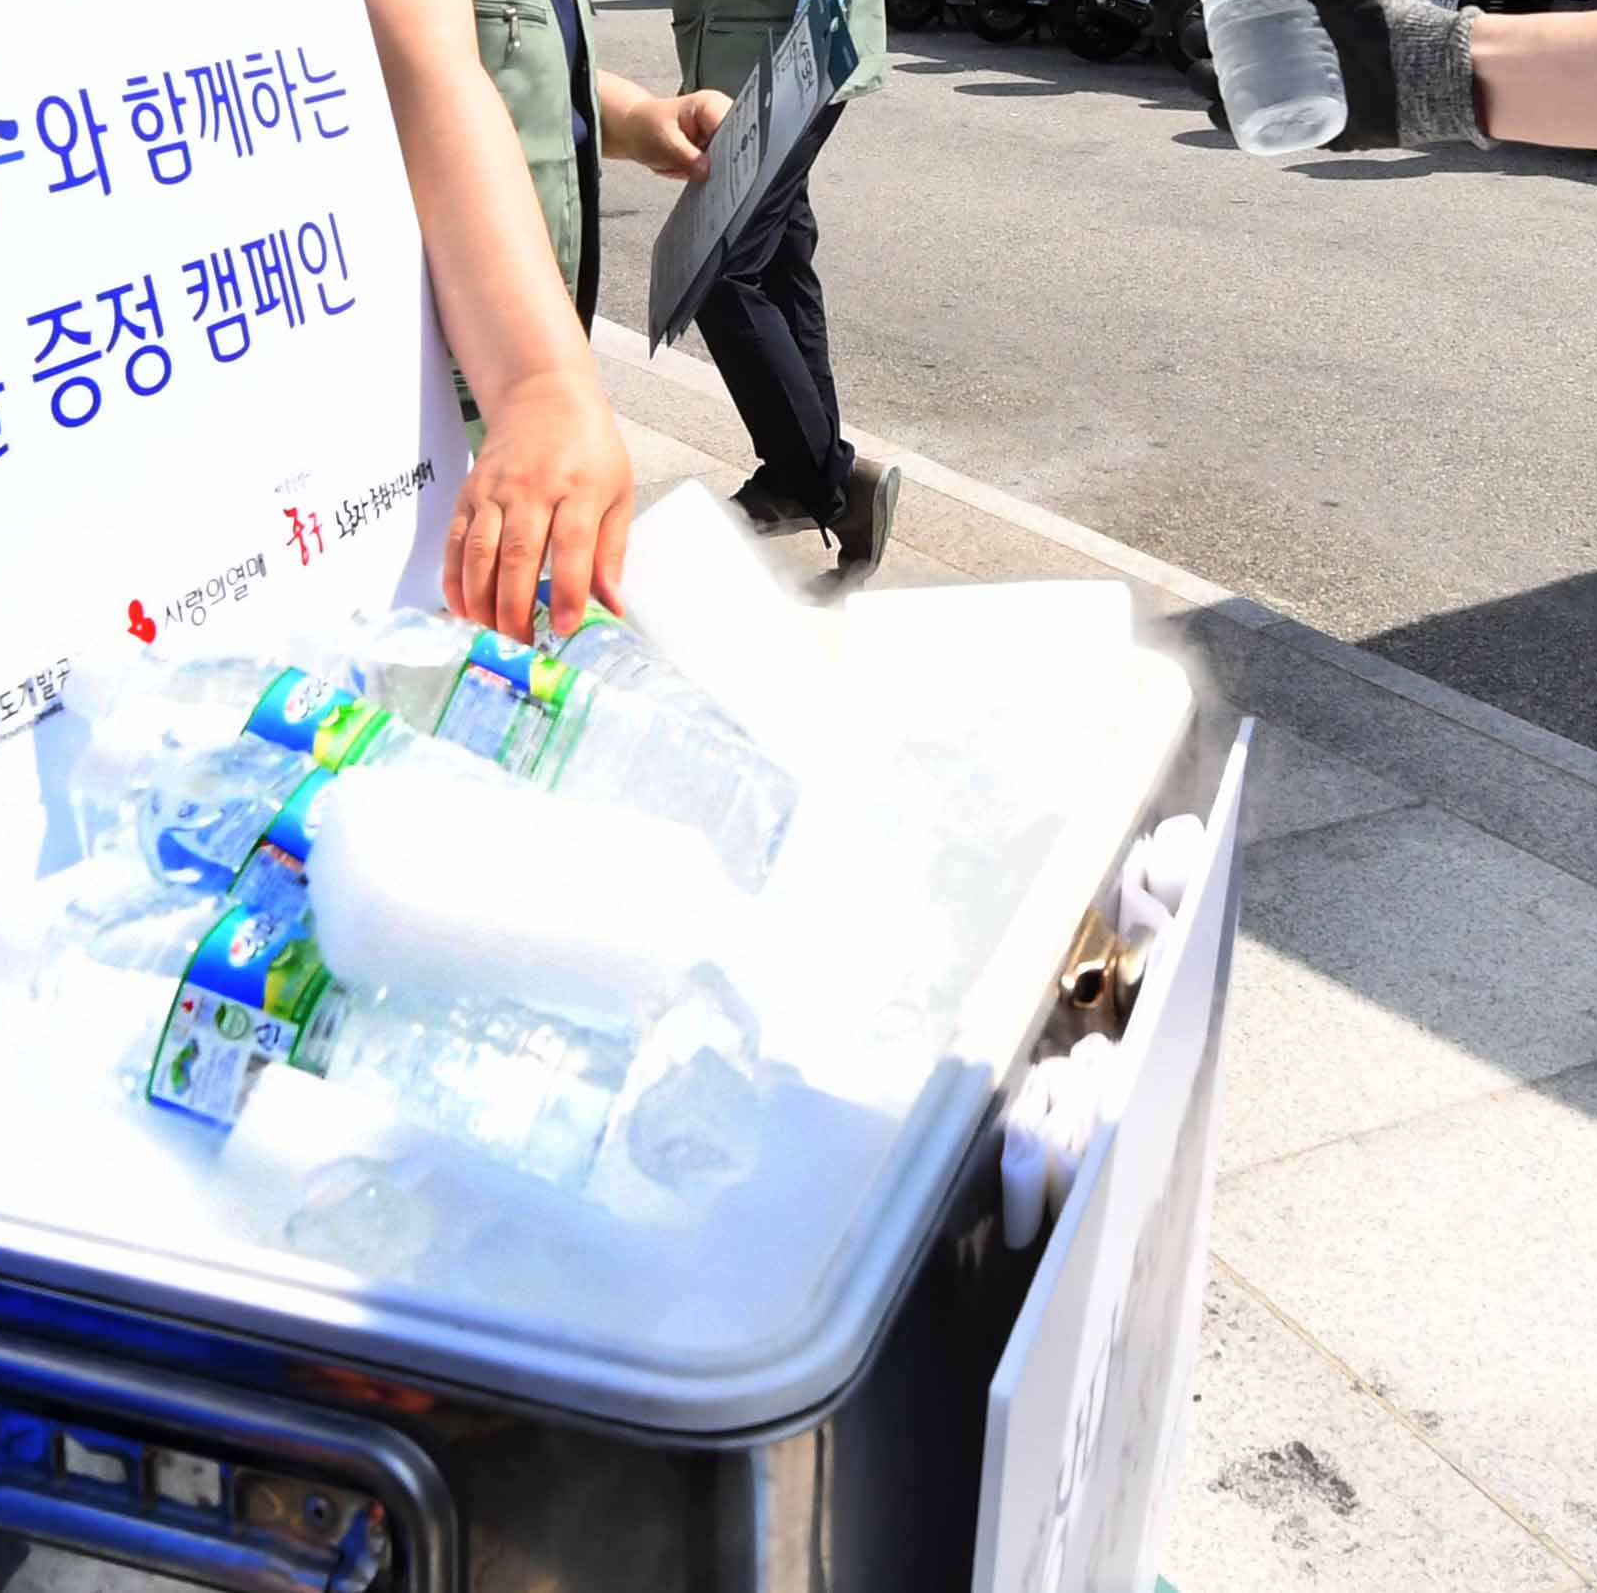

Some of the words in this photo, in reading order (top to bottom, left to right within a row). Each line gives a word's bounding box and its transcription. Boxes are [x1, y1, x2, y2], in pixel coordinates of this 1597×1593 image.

[121, 44, 353, 174] 함께하는
[29, 273, 176, 430] 증정
[179, 212, 359, 363] 캠페인
[283, 506, 324, 566] 중구
[162, 551, 269, 628] 사랑의열매
